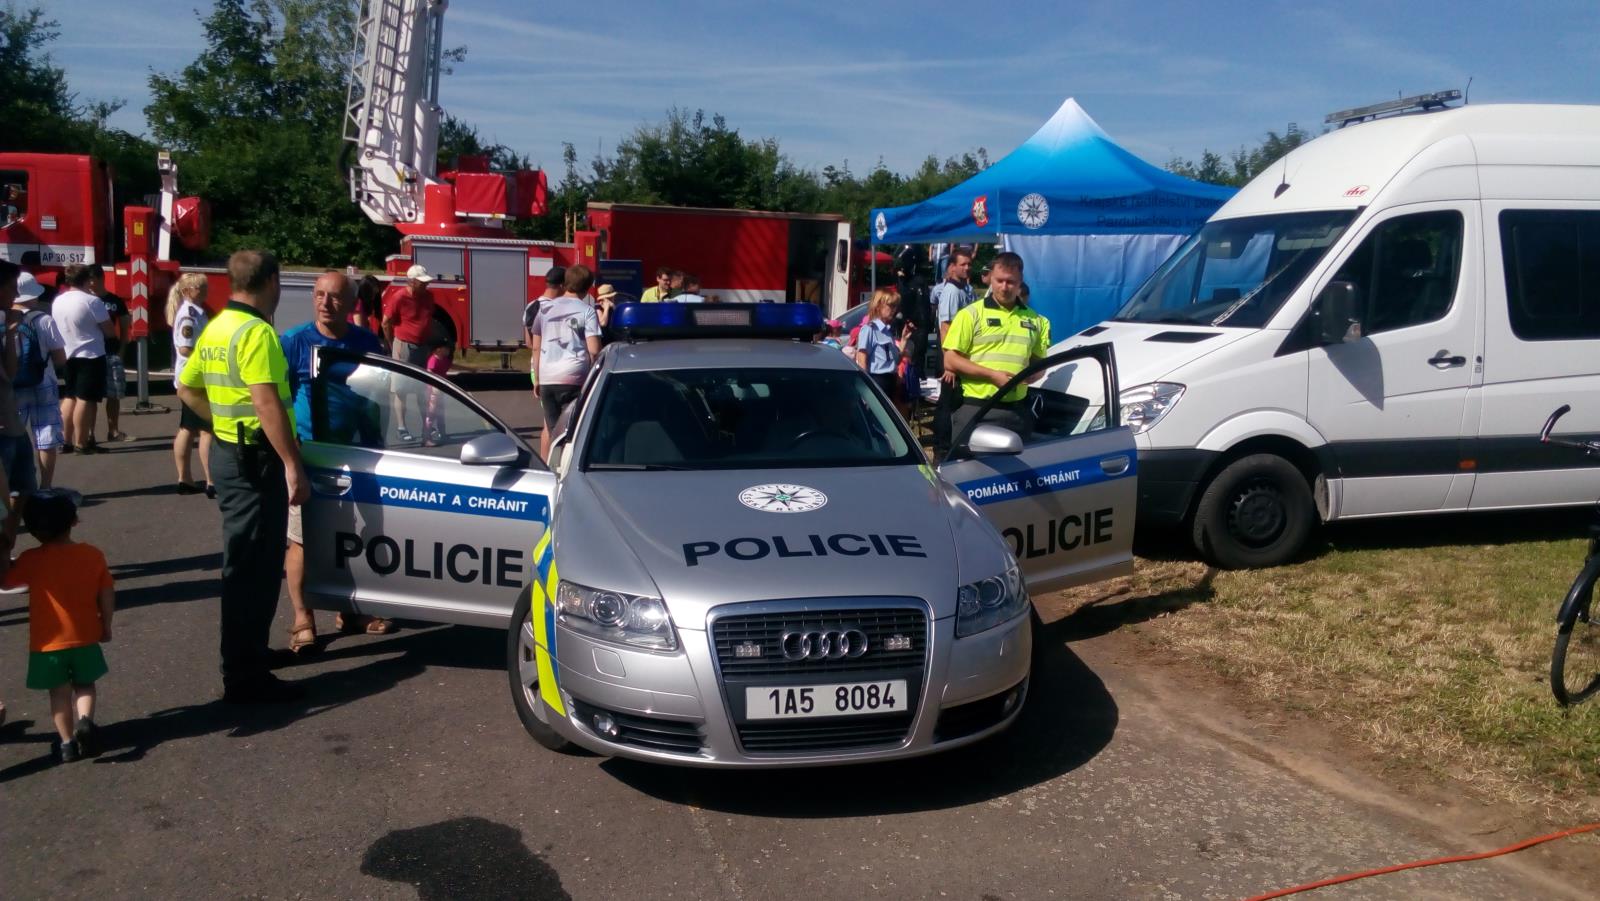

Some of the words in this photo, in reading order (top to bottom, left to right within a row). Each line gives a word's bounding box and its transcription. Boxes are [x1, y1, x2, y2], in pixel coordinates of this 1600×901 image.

[380, 486, 446, 504] POMÁHAT
[452, 495, 462, 506] A
[468, 496, 528, 513] CHRÁNIT
[967, 482, 1019, 500] POMÁHAT
[1025, 480, 1032, 489] A
[1036, 470, 1080, 487] CHRÁNIT
[1002, 507, 1113, 559] OLICIE
[335, 531, 524, 589] POLICIE
[682, 533, 929, 567] POLICIE
[769, 687, 815, 714] 1A5
[835, 683, 896, 712] 8084
